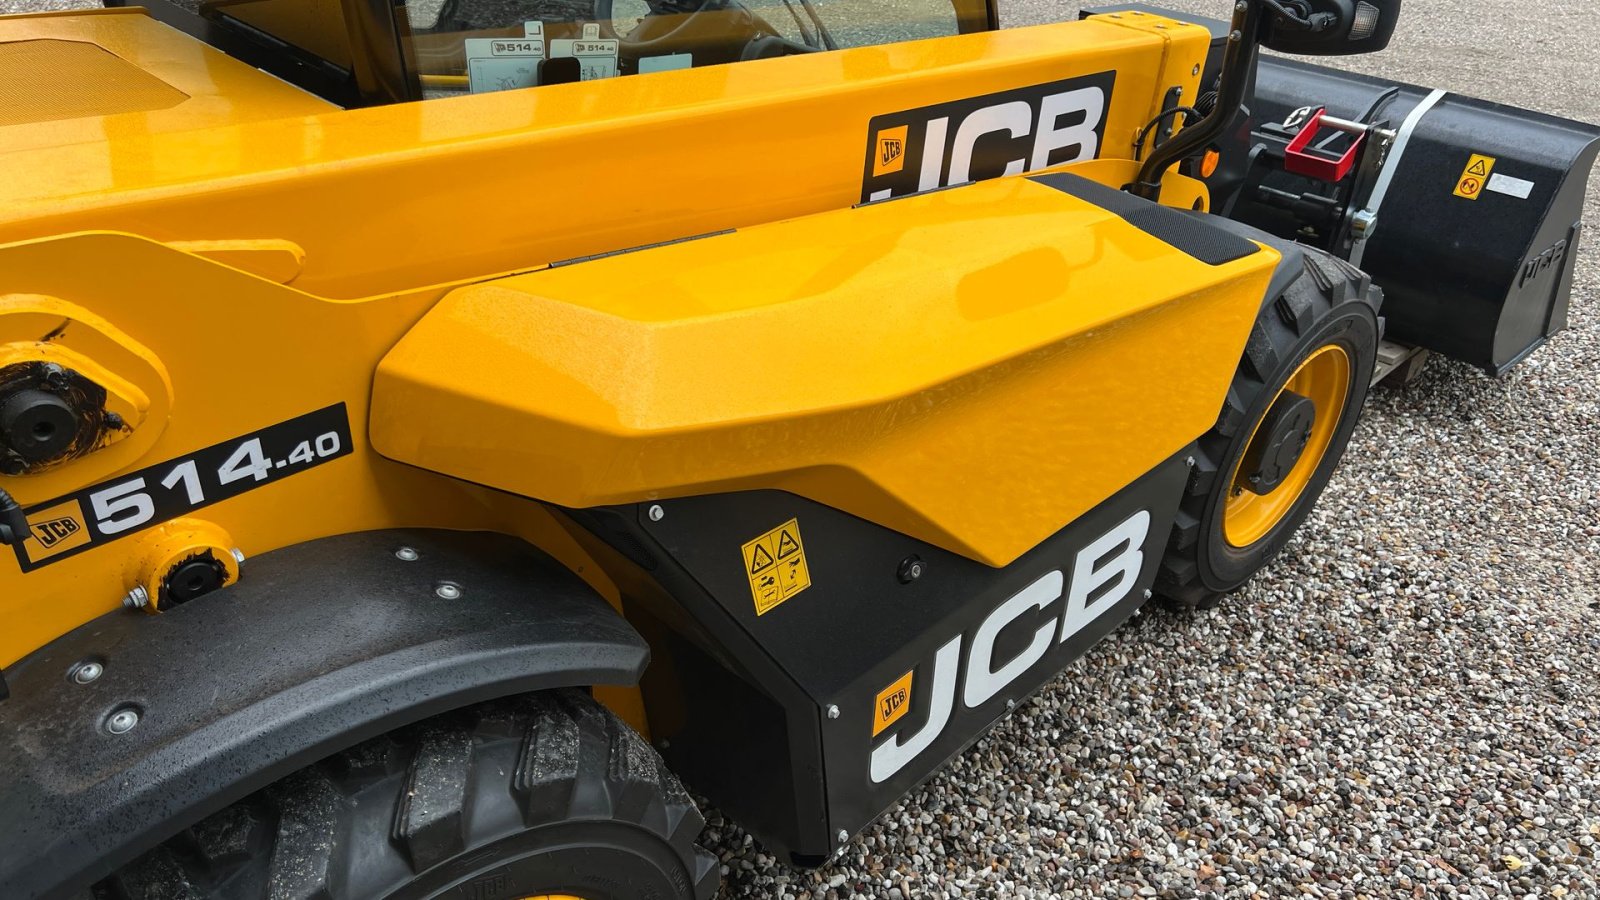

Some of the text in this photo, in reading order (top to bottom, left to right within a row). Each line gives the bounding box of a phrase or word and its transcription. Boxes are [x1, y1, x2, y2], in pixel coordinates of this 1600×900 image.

[506, 43, 532, 52] 514
[869, 86, 1104, 202] JCB
[882, 140, 902, 162] JCB
[39, 518, 78, 547] JCB
[869, 509, 1151, 784] JCB
[883, 688, 906, 717] JCB
